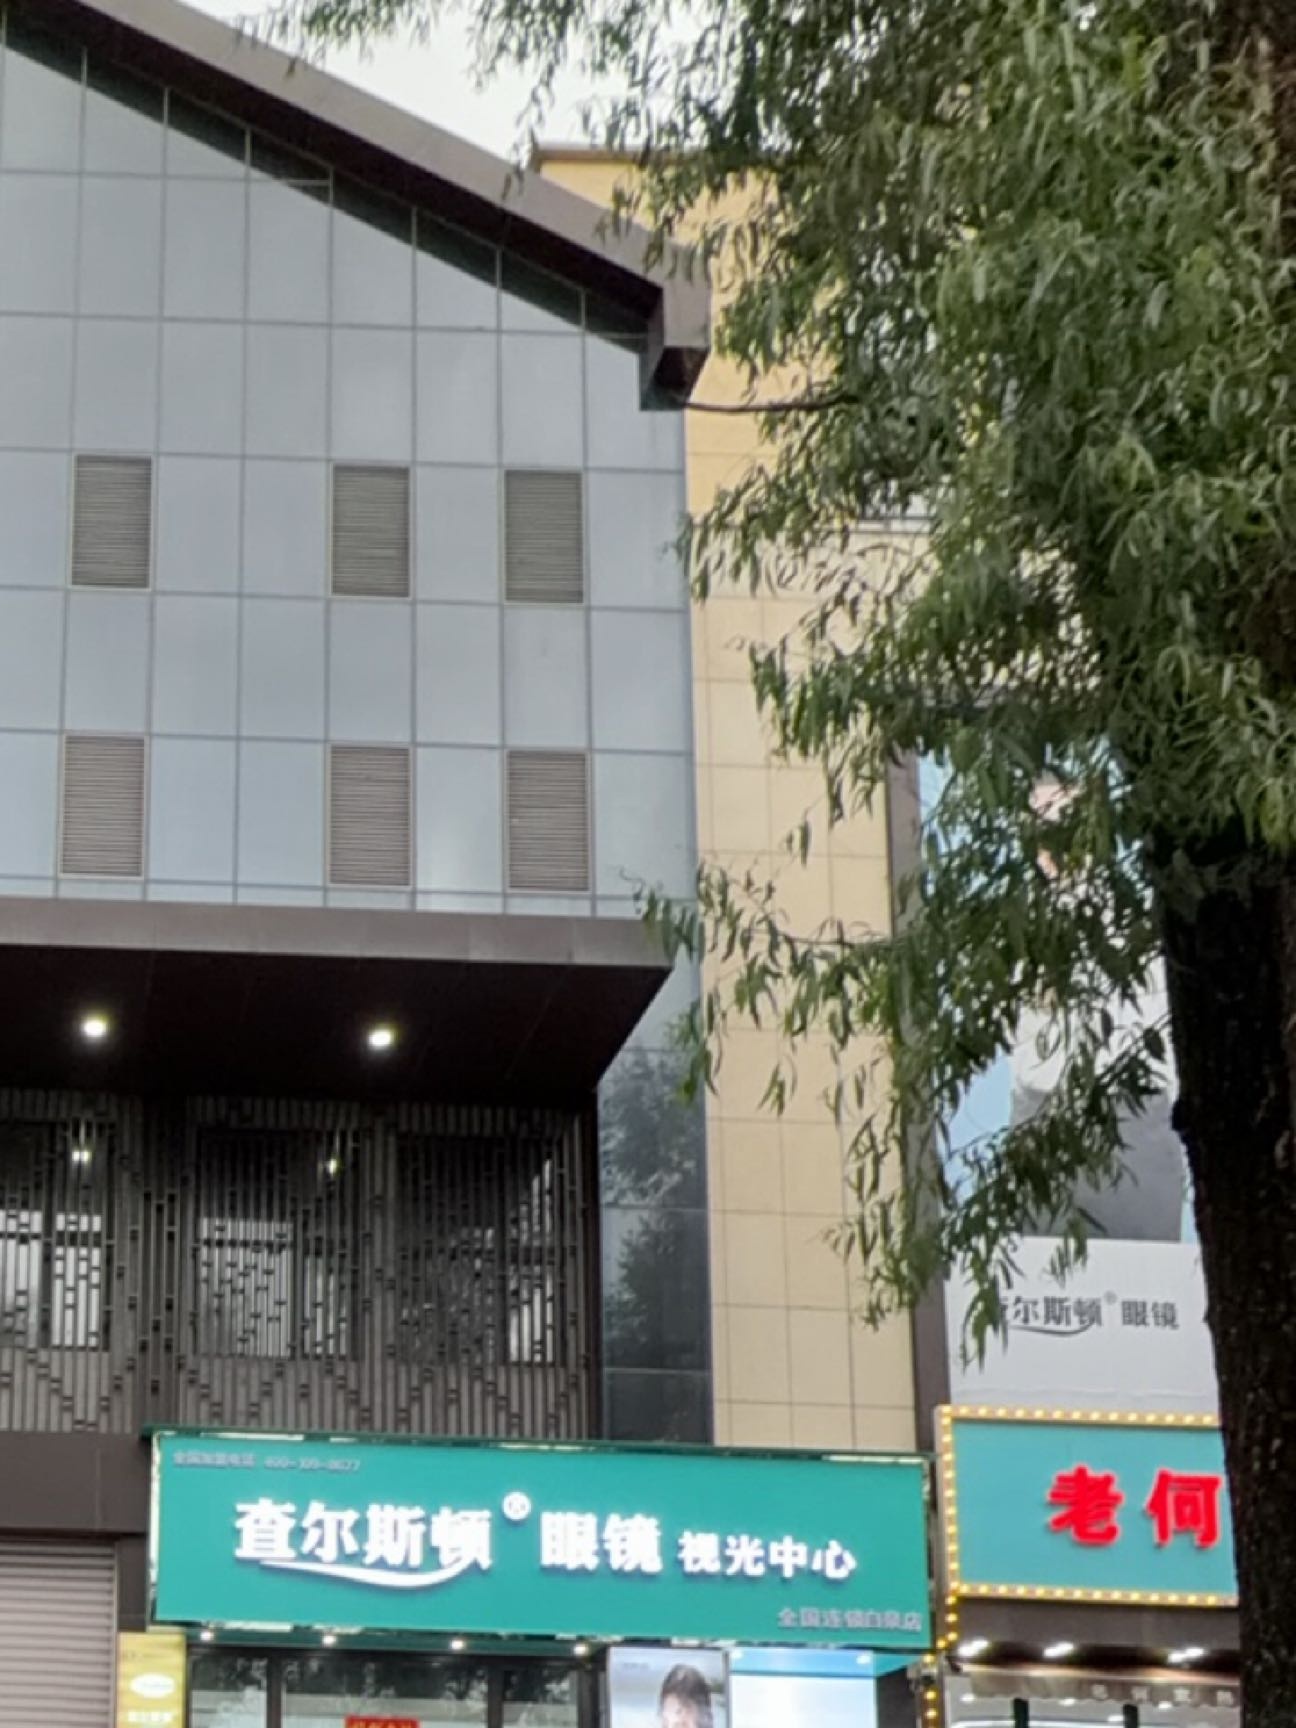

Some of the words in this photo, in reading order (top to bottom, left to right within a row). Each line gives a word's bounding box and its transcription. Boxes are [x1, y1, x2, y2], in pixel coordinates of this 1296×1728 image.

[1120, 1299, 1180, 1330] 眼镜
[232, 1496, 493, 1574] 查尔斯顿
[540, 1512, 663, 1575] 眼镜
[677, 1530, 857, 1580] 视光中心
